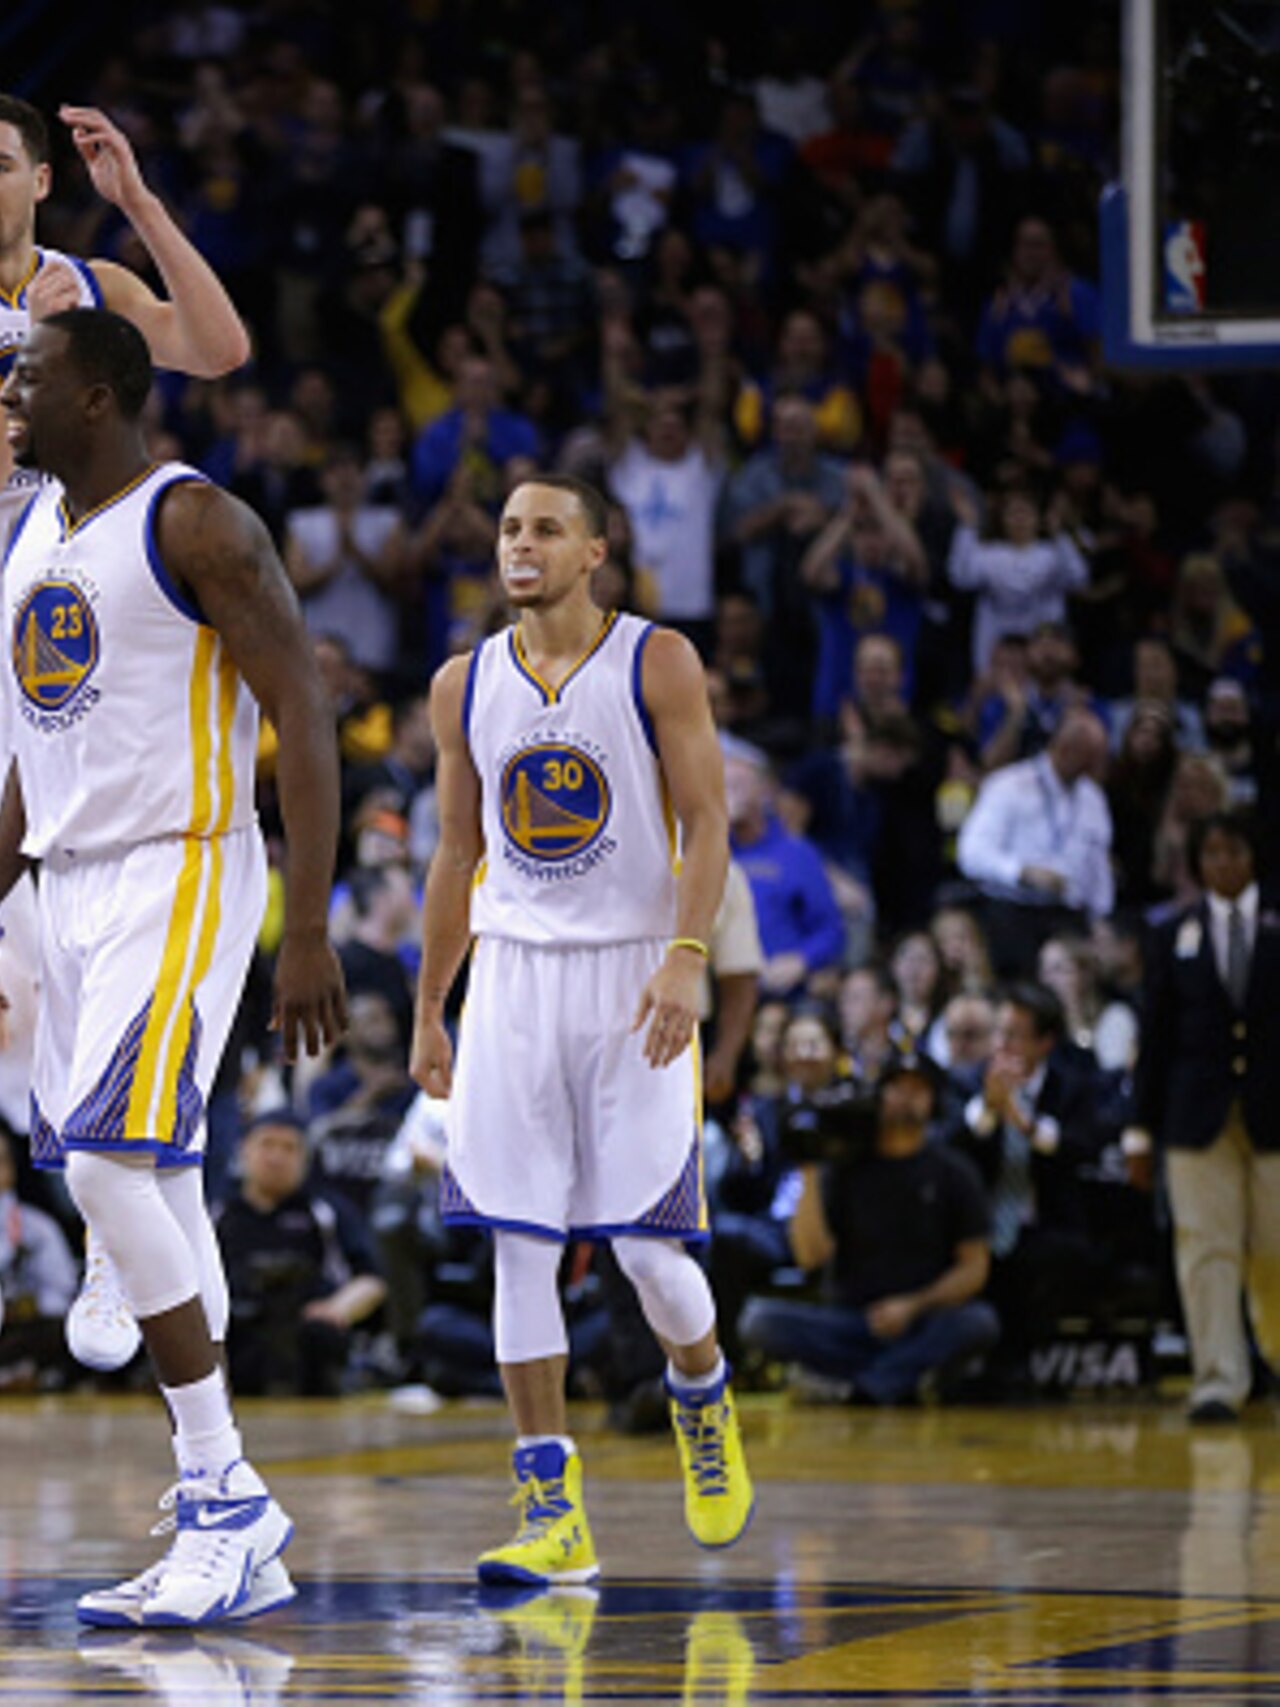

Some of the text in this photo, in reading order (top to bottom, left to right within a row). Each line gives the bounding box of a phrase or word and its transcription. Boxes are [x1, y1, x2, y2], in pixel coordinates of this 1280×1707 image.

[51, 604, 83, 639] 23
[542, 759, 583, 790] 30
[503, 834, 618, 881] WARRIORS
[1029, 1341, 1140, 1384] VISA
